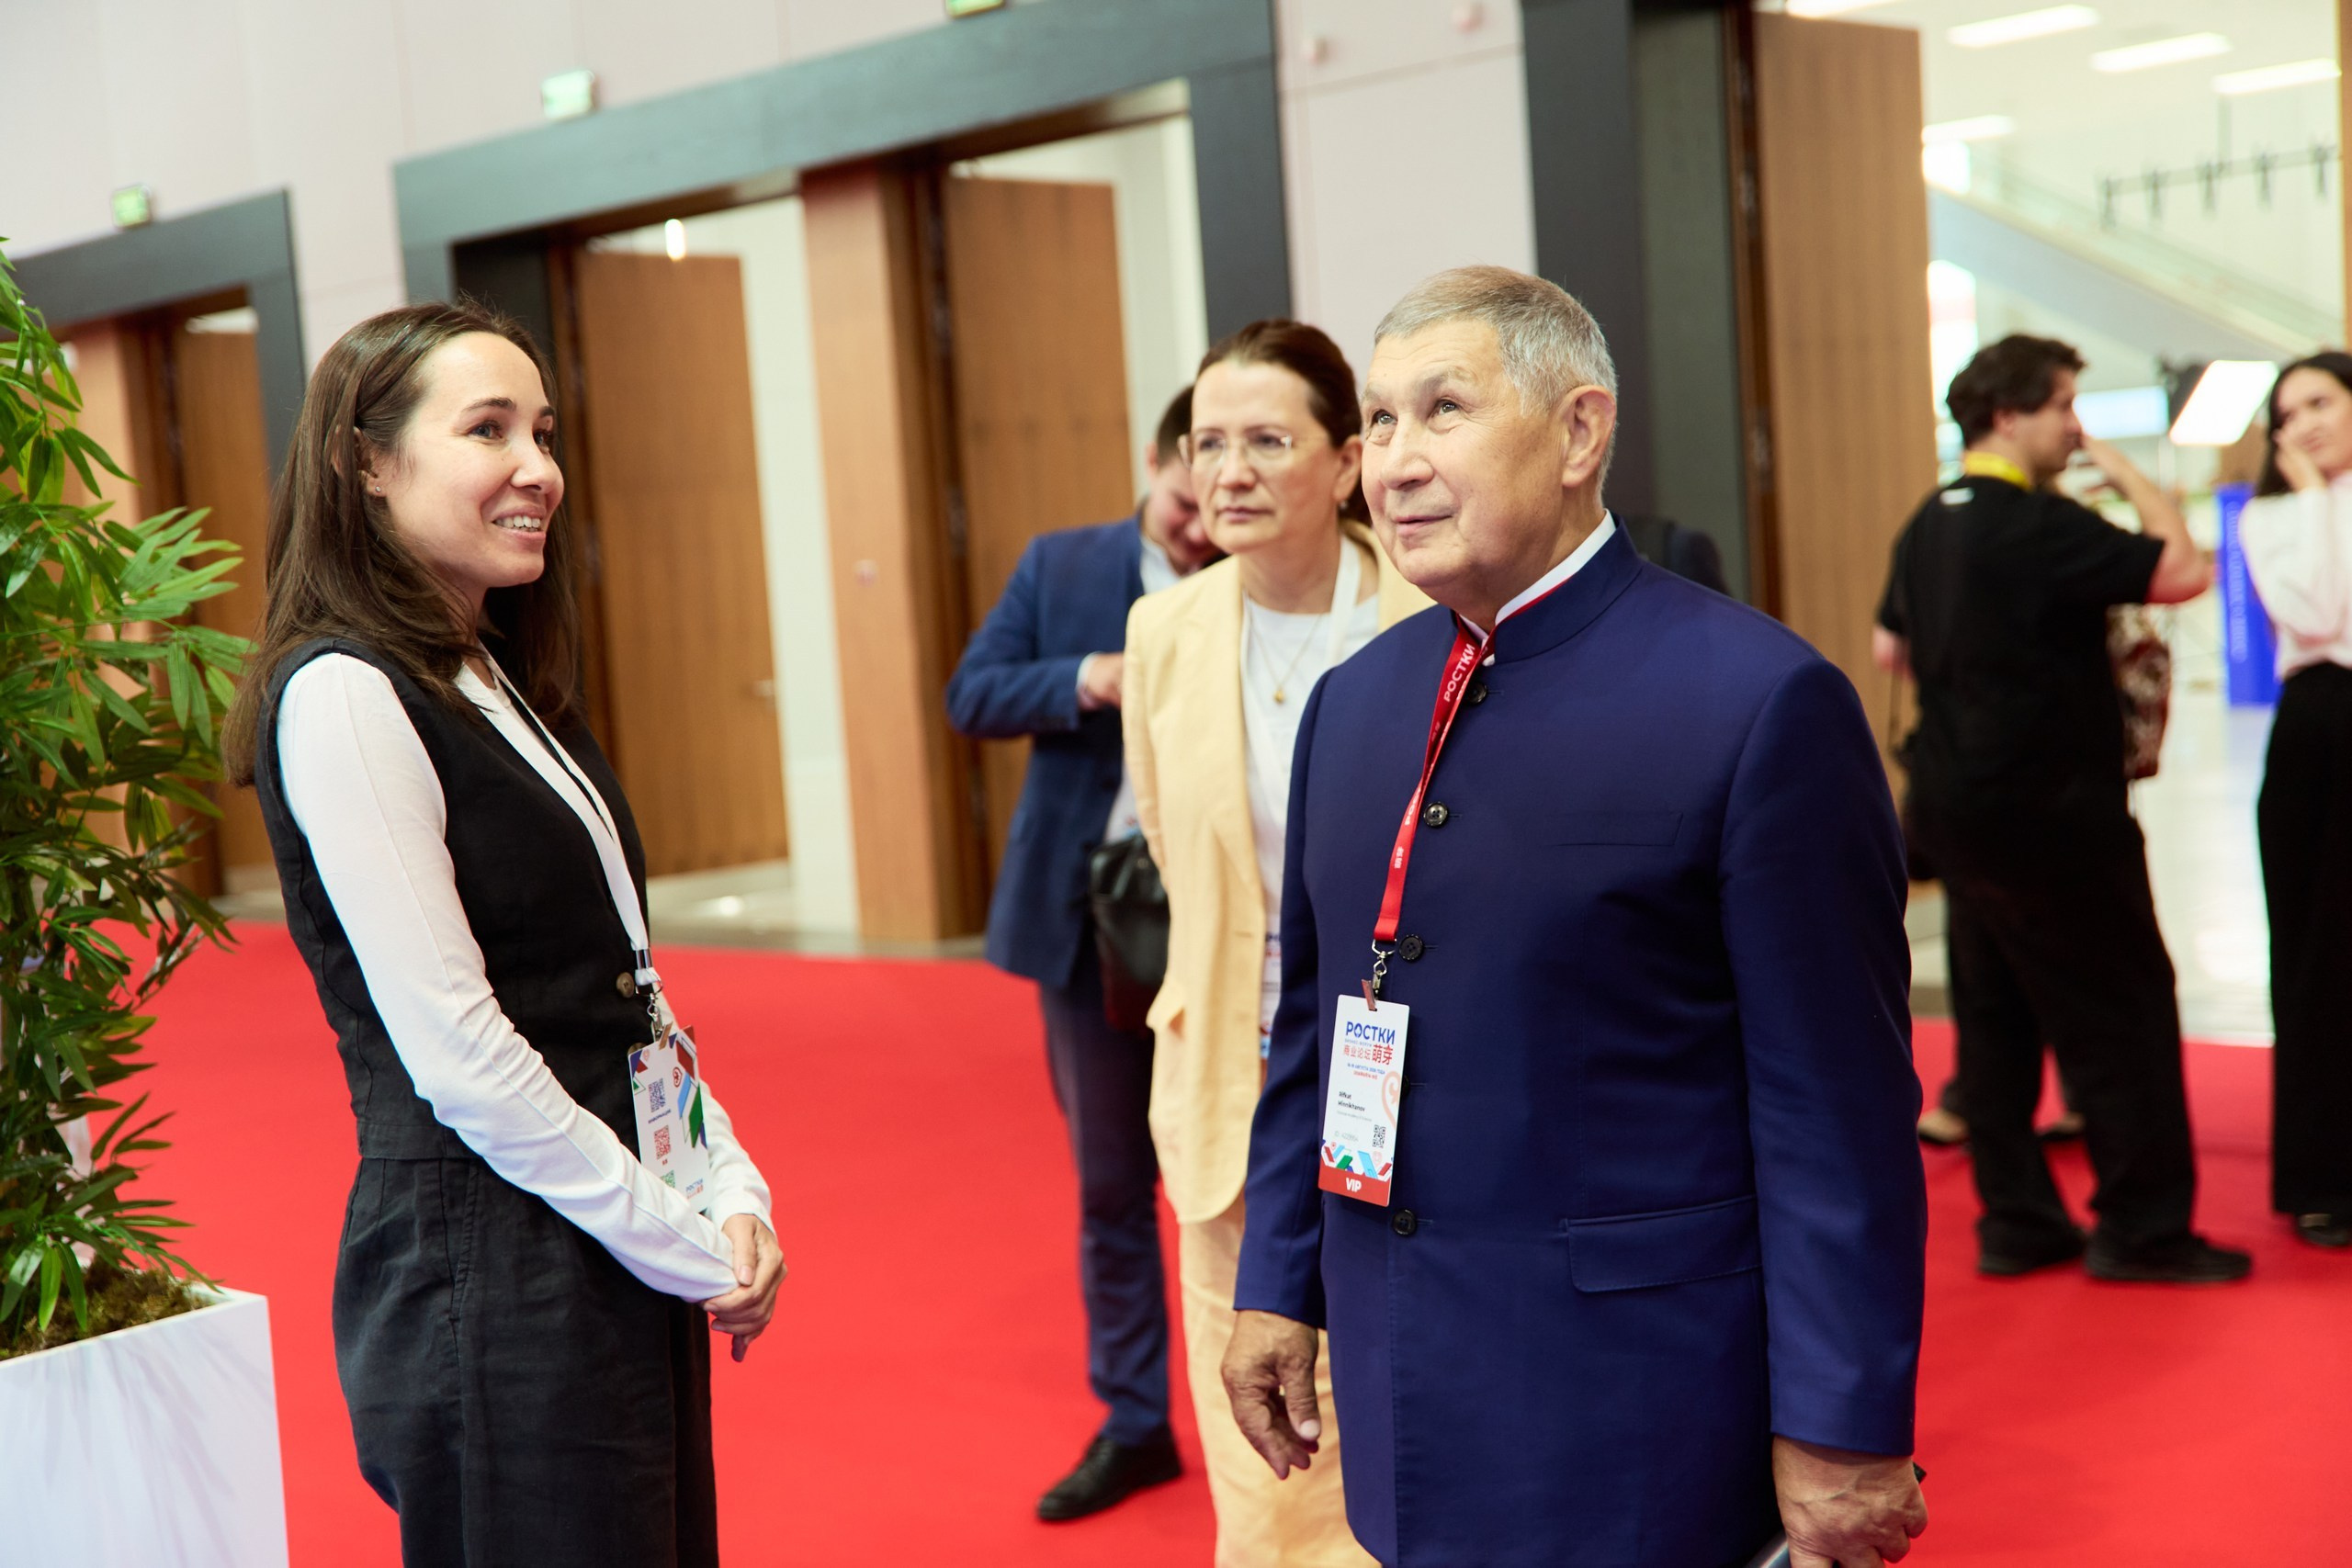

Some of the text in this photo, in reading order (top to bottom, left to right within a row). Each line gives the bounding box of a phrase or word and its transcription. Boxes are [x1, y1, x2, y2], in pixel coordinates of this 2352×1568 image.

[1443, 643, 1476, 703] РОСТКИ
[1345, 1021, 1396, 1045] РОСТКИ
[1372, 1043, 1394, 1066] 萌芽
[1345, 1177, 1362, 1192] VIP
